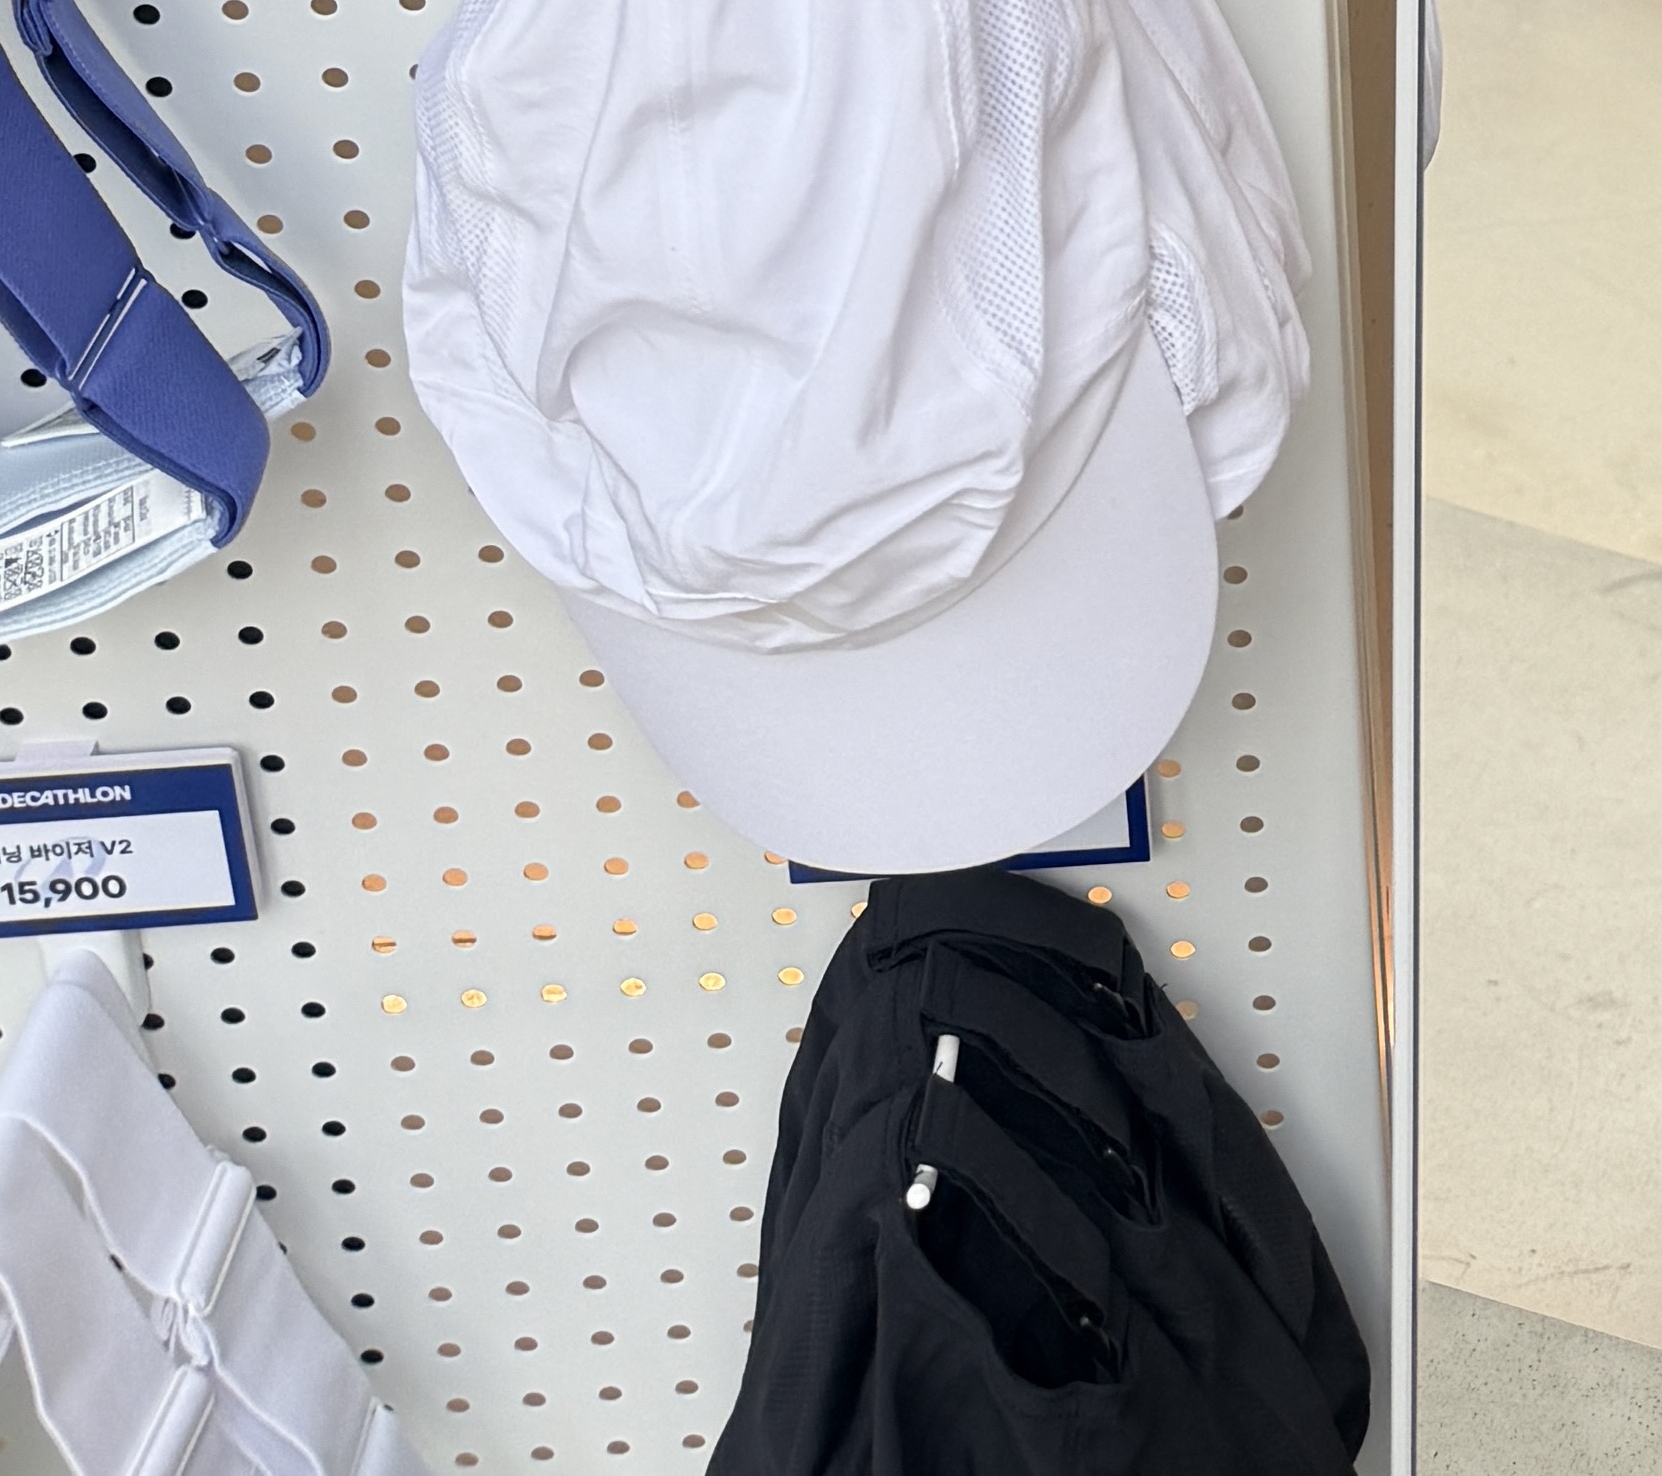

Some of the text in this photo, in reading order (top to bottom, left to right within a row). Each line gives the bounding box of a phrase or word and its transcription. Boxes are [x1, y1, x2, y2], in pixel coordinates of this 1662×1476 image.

[0, 838, 133, 865] 닝 바이져 V2
[0, 874, 127, 908] 15,900
